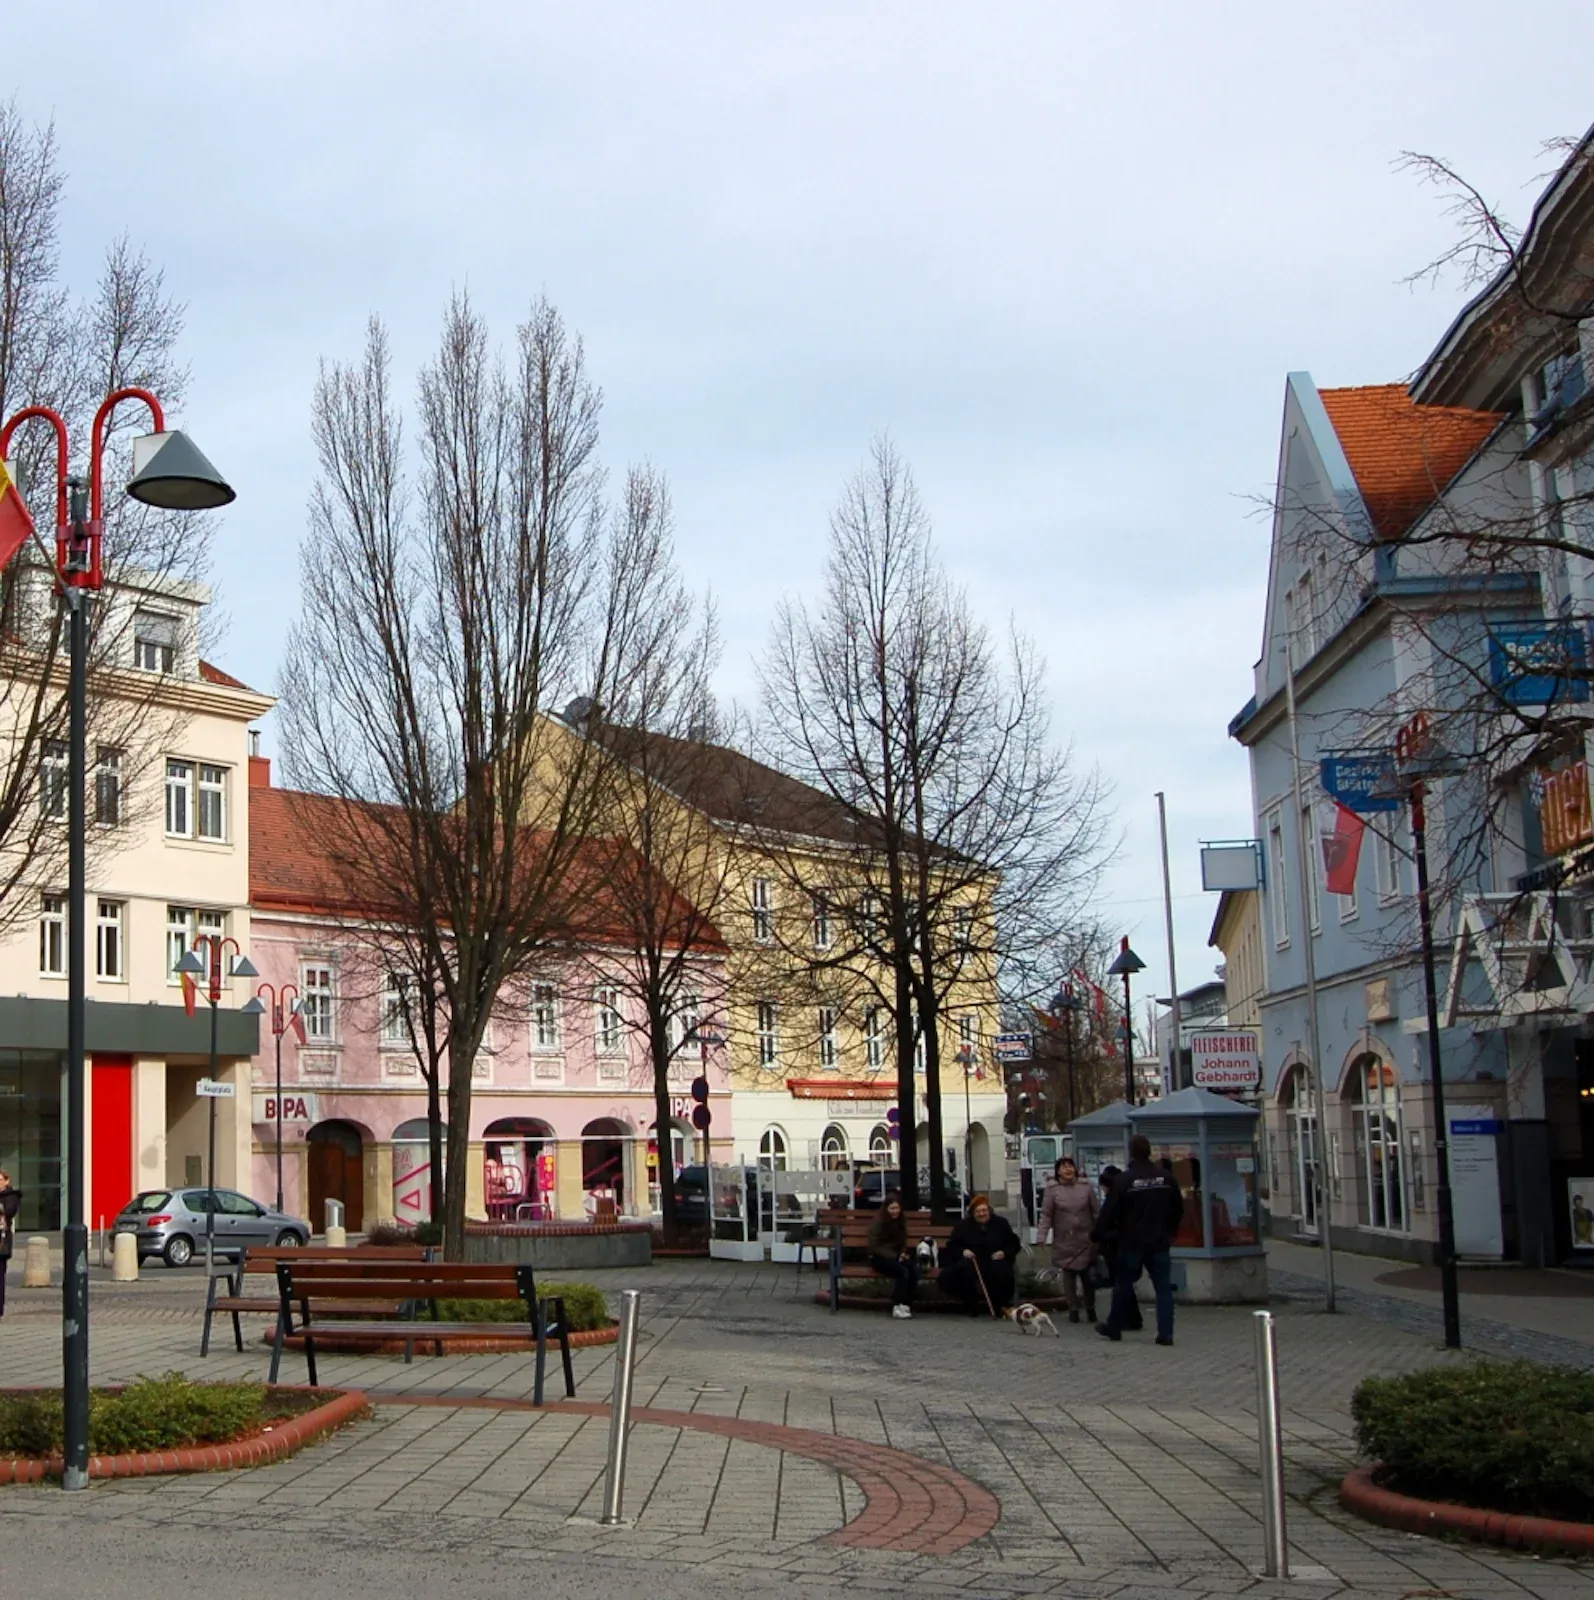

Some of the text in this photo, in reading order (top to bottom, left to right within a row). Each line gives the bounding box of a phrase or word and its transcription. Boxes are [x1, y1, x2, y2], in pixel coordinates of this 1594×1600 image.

[1193, 1036, 1256, 1053] FLEISCHEREI
[1201, 1057, 1250, 1069] Johann
[1195, 1070, 1257, 1083] Gebhardt
[265, 1097, 308, 1119] BPA
[669, 1097, 691, 1118] IPA
